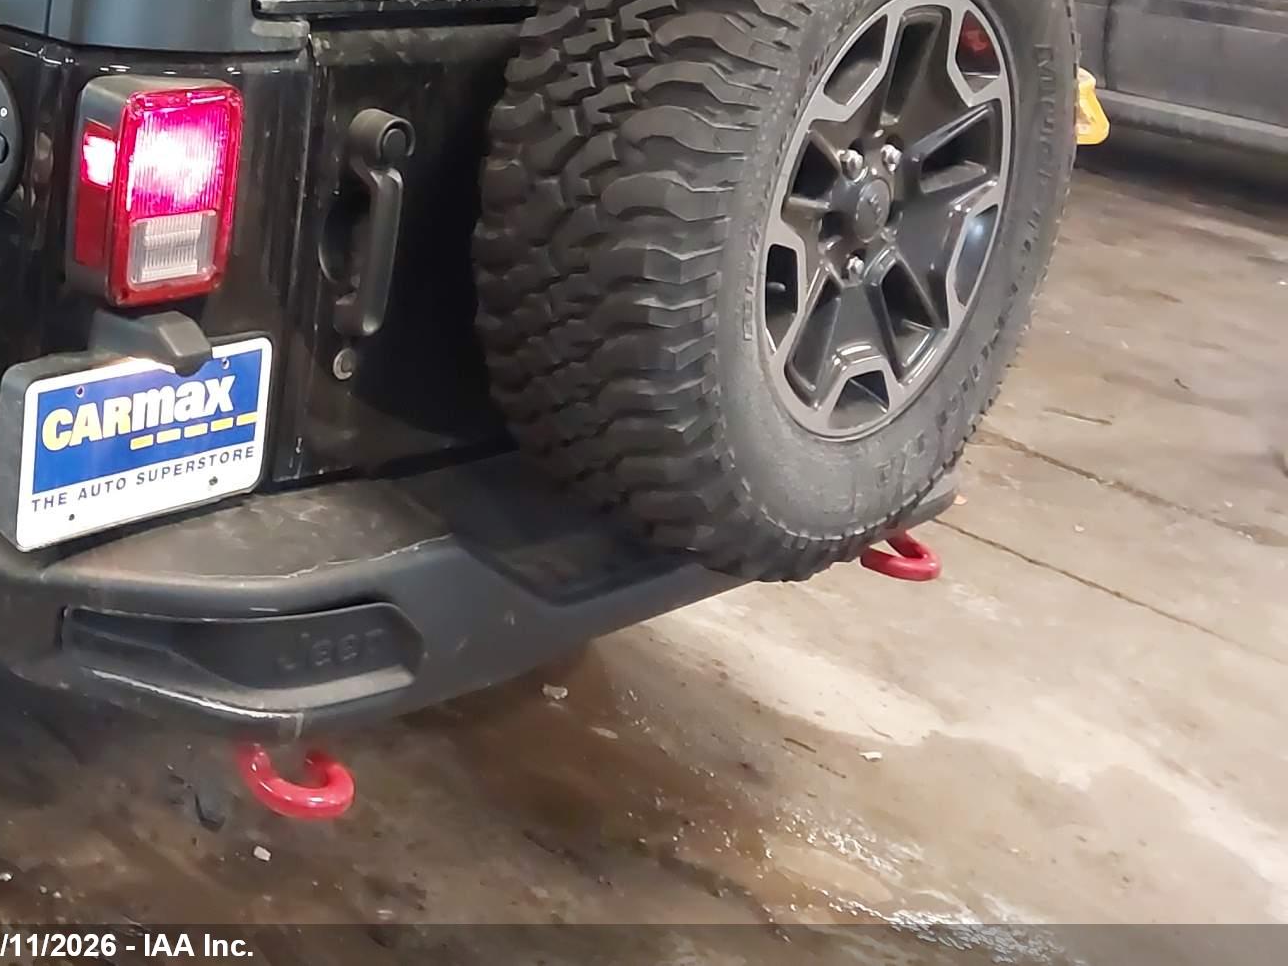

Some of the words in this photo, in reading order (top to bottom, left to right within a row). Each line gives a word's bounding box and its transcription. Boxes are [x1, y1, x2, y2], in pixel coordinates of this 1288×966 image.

[31, 492, 68, 513] THE
[77, 477, 127, 501] AUTO
[135, 445, 255, 485] SUPERSTORE
